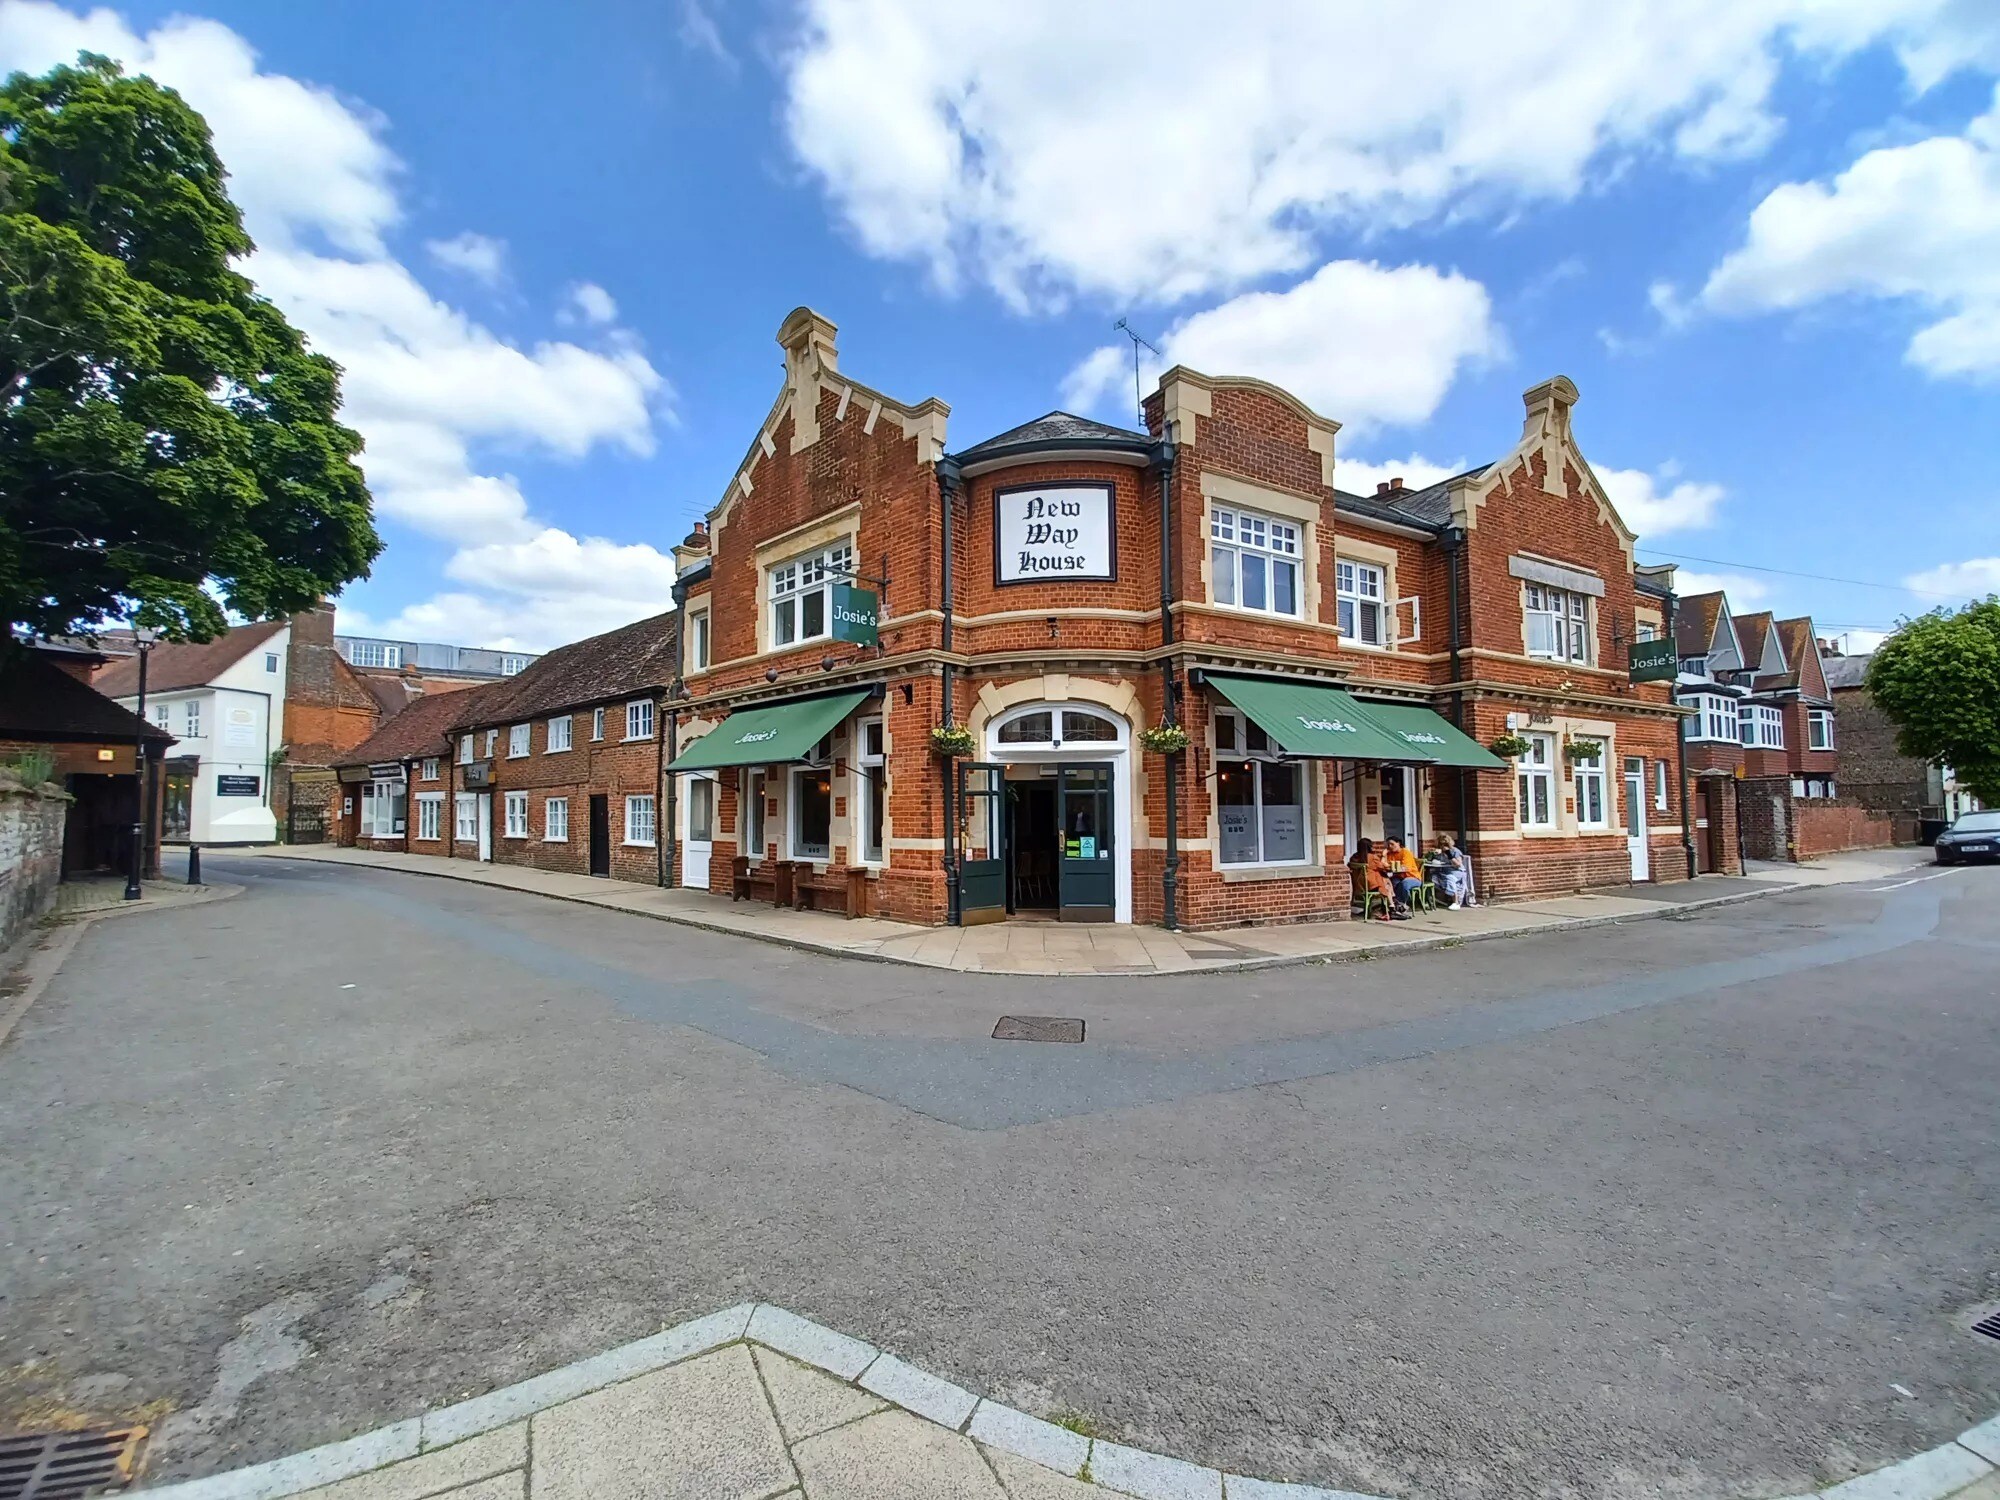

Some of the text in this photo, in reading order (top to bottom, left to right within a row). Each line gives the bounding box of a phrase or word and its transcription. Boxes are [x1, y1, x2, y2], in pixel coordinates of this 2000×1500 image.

[1022, 497, 1080, 520] New
[1025, 523, 1078, 549] Way
[833, 605, 876, 626] Josie's
[1630, 653, 1675, 670] Josie's
[1296, 716, 1357, 733] Josie's
[1397, 730, 1446, 744] Josie's
[1224, 814, 1248, 825] Josie's
